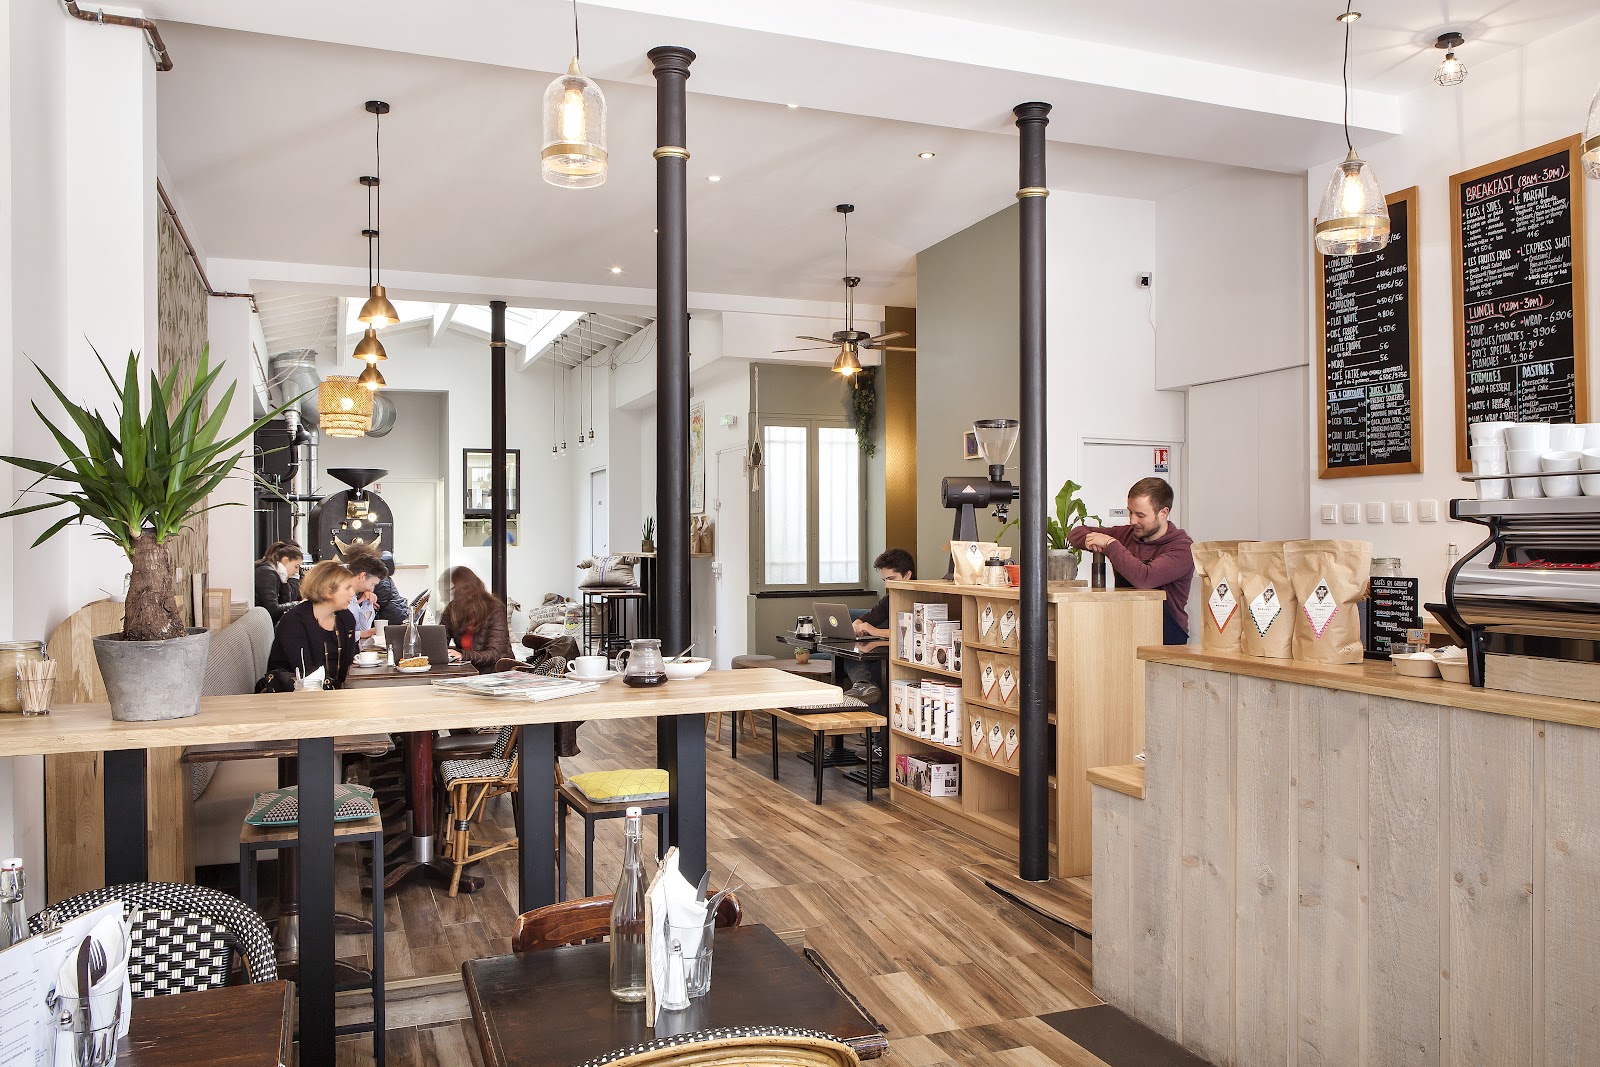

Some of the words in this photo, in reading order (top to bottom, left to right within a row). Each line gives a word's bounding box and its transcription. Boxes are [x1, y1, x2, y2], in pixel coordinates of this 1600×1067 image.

[1466, 174, 1514, 202] BREAKFAST
[1513, 194, 1520, 205] LE
[1523, 186, 1548, 202] PARFAIT
[1466, 206, 1480, 219] EGGS
[1486, 199, 1501, 212] SIDES
[1520, 239, 1552, 256] L'EXPRESS
[1554, 235, 1571, 249] SHOT
[1328, 258, 1340, 268] LONG
[1468, 256, 1476, 267] LES
[1478, 251, 1495, 265] FRUITS
[1469, 302, 1495, 319] LUNCH
[1331, 316, 1342, 327] FLAT
[1343, 312, 1358, 324] WHITE
[1523, 314, 1543, 327] WRAP
[1470, 323, 1485, 336] SOUP
[1331, 342, 1345, 353] LATTE
[1490, 343, 1511, 355] SPECIAL
[1472, 356, 1499, 370] PLANCHES
[1522, 362, 1554, 378] PASTRIES
[1471, 370, 1502, 385] FORMULES
[1471, 385, 1485, 395] WRAP
[1490, 382, 1511, 393] DESSERT
[1331, 403, 1340, 411] TEA
[1332, 417, 1342, 425] ICED
[1343, 416, 1352, 425] TEA
[1344, 430, 1356, 440] LATTE
[1332, 443, 1341, 452] HOT
